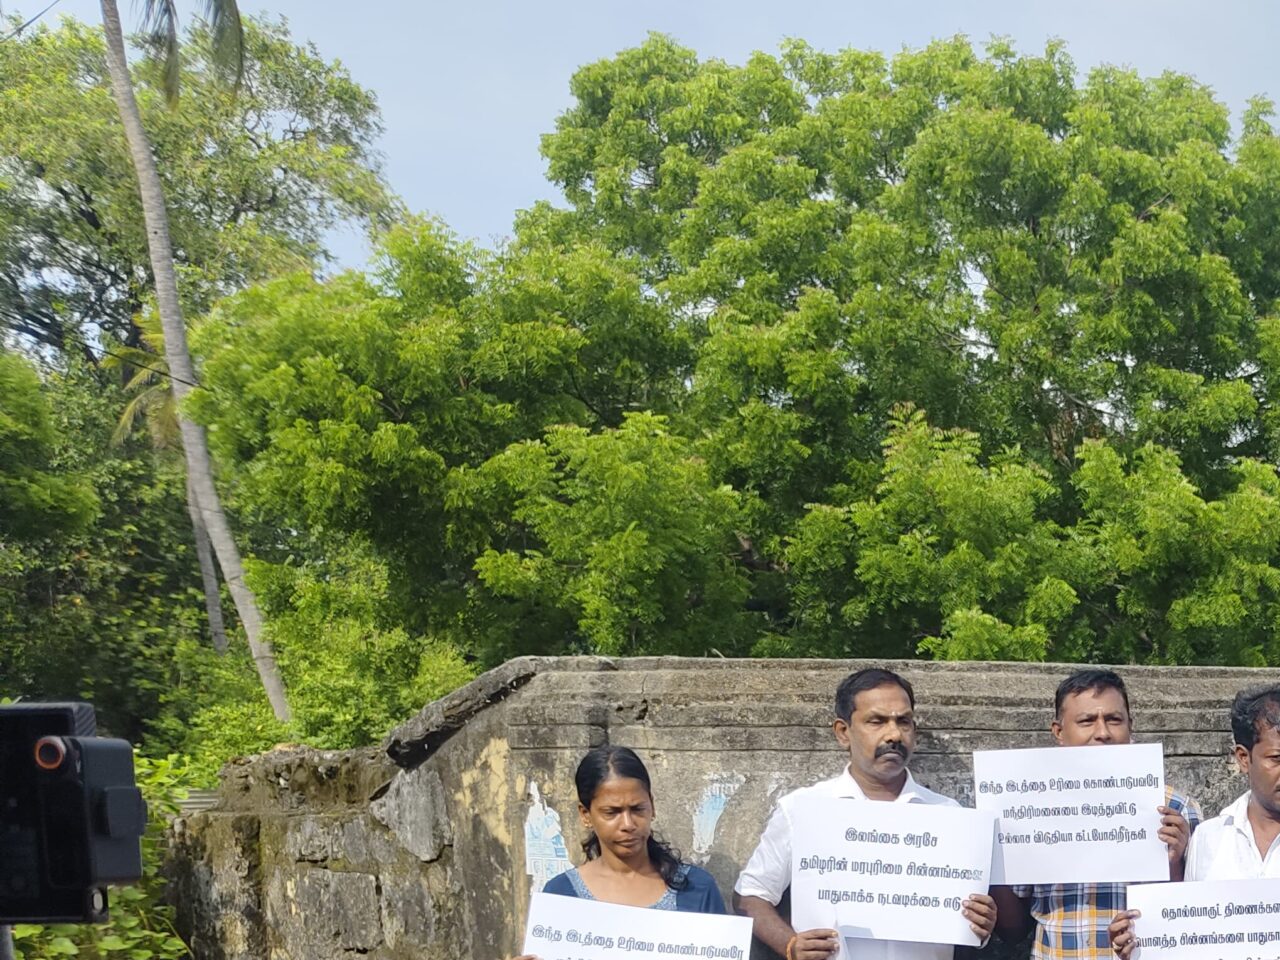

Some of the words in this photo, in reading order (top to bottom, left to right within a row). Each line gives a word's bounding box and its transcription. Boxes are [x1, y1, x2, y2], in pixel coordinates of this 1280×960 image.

[845, 827, 900, 845] இலங்கை
[903, 832, 938, 848] அரசே
[532, 925, 562, 942] இந்த
[1180, 931, 1245, 947] சின்னங்களை
